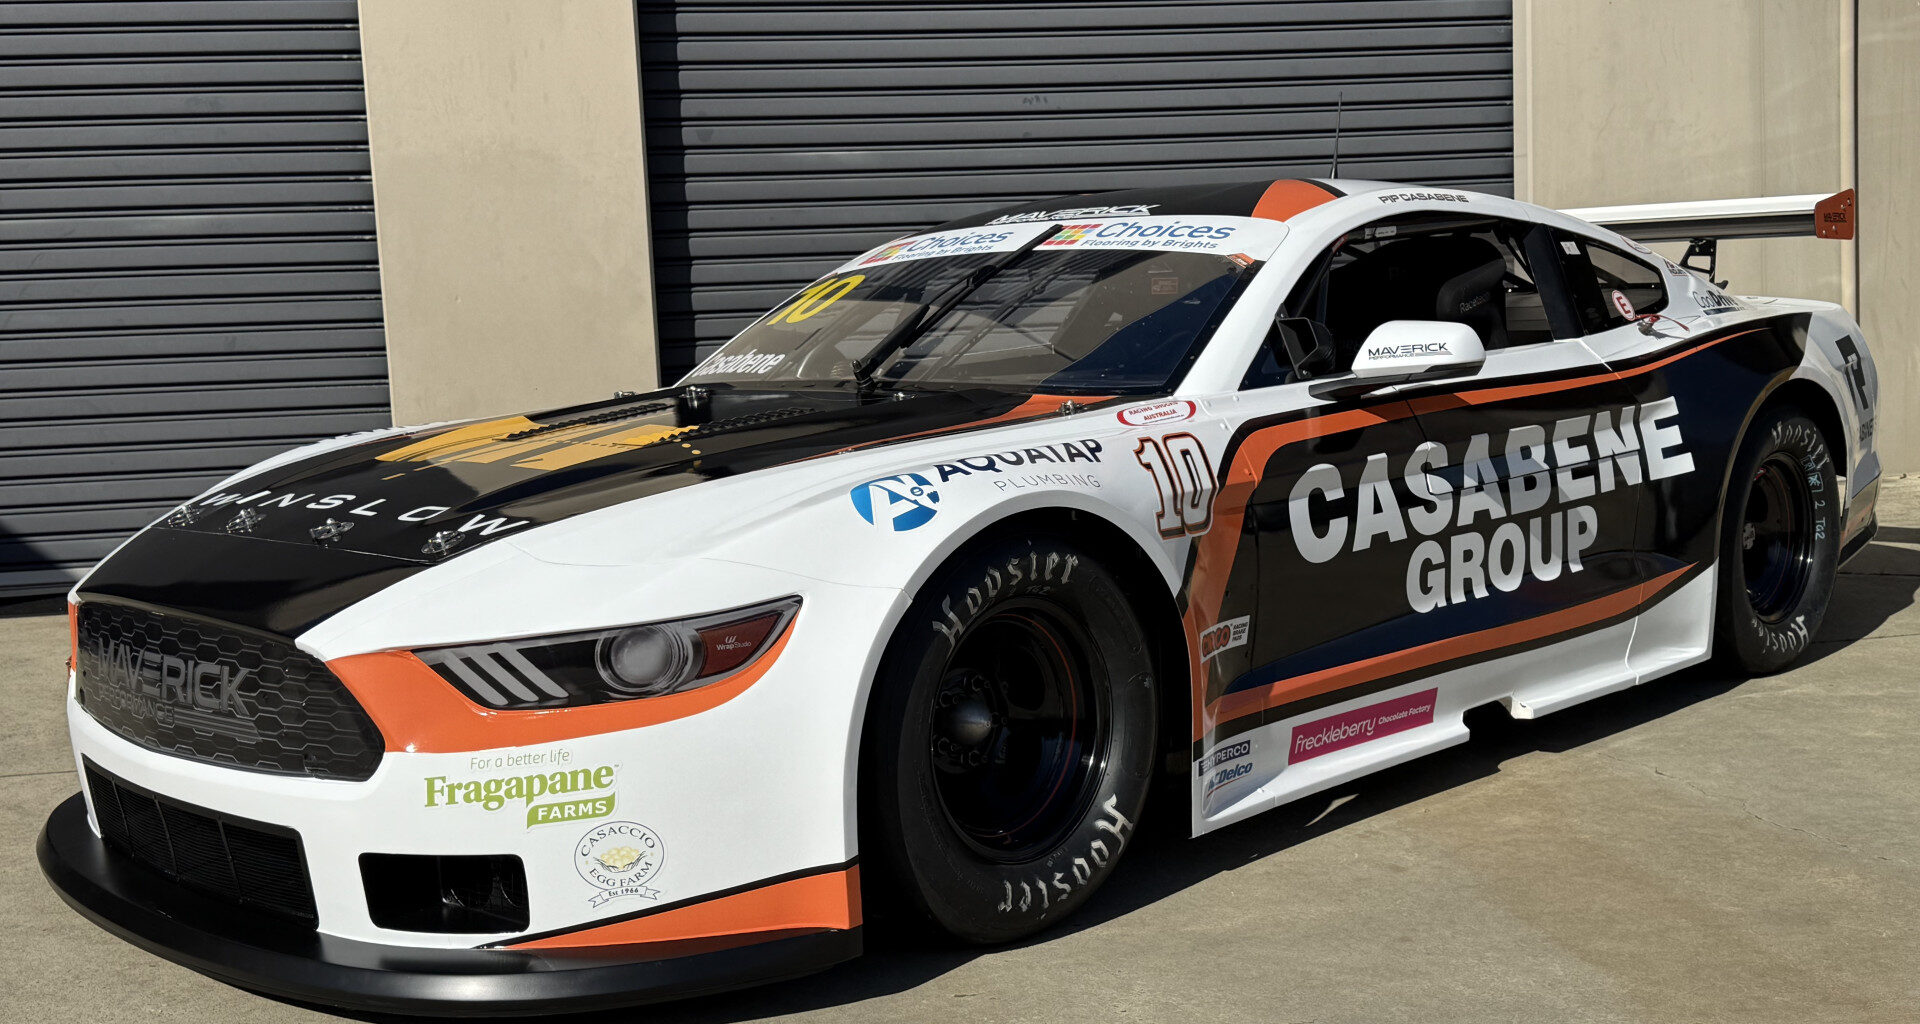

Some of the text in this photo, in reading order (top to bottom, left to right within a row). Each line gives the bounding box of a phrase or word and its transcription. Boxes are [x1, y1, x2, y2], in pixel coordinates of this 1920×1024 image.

[1378, 193, 1470, 203] PIP CASABENE
[907, 231, 1015, 252] Choices
[1096, 221, 1237, 240] Choices
[951, 244, 994, 255] Brights
[1080, 239, 1218, 250] Flooring by Brights
[766, 274, 866, 326] 10
[1616, 295, 1631, 315] E
[1368, 342, 1448, 357] MAVERICK
[1128, 405, 1153, 416] RACING
[1143, 408, 1178, 421] AUSTRALIA
[993, 473, 1101, 492] PLUMBING
[1132, 431, 1219, 540] 10
[1288, 395, 1696, 565] CASABENE
[201, 490, 530, 537] WINSLOW
[1405, 504, 1599, 614] GROUP
[932, 538, 1079, 653] Hoosier
[98, 636, 251, 717] MAVERICK
[1294, 703, 1432, 755] freckleberry Chocolate Factory
[470, 748, 570, 770] For a better life
[424, 765, 614, 812] Fragapane
[537, 800, 608, 821] FARMS
[580, 825, 656, 858] CASACCIO
[998, 793, 1134, 920] Hoosier
[589, 861, 653, 887] EGG FARM
[621, 887, 639, 895] 1966
